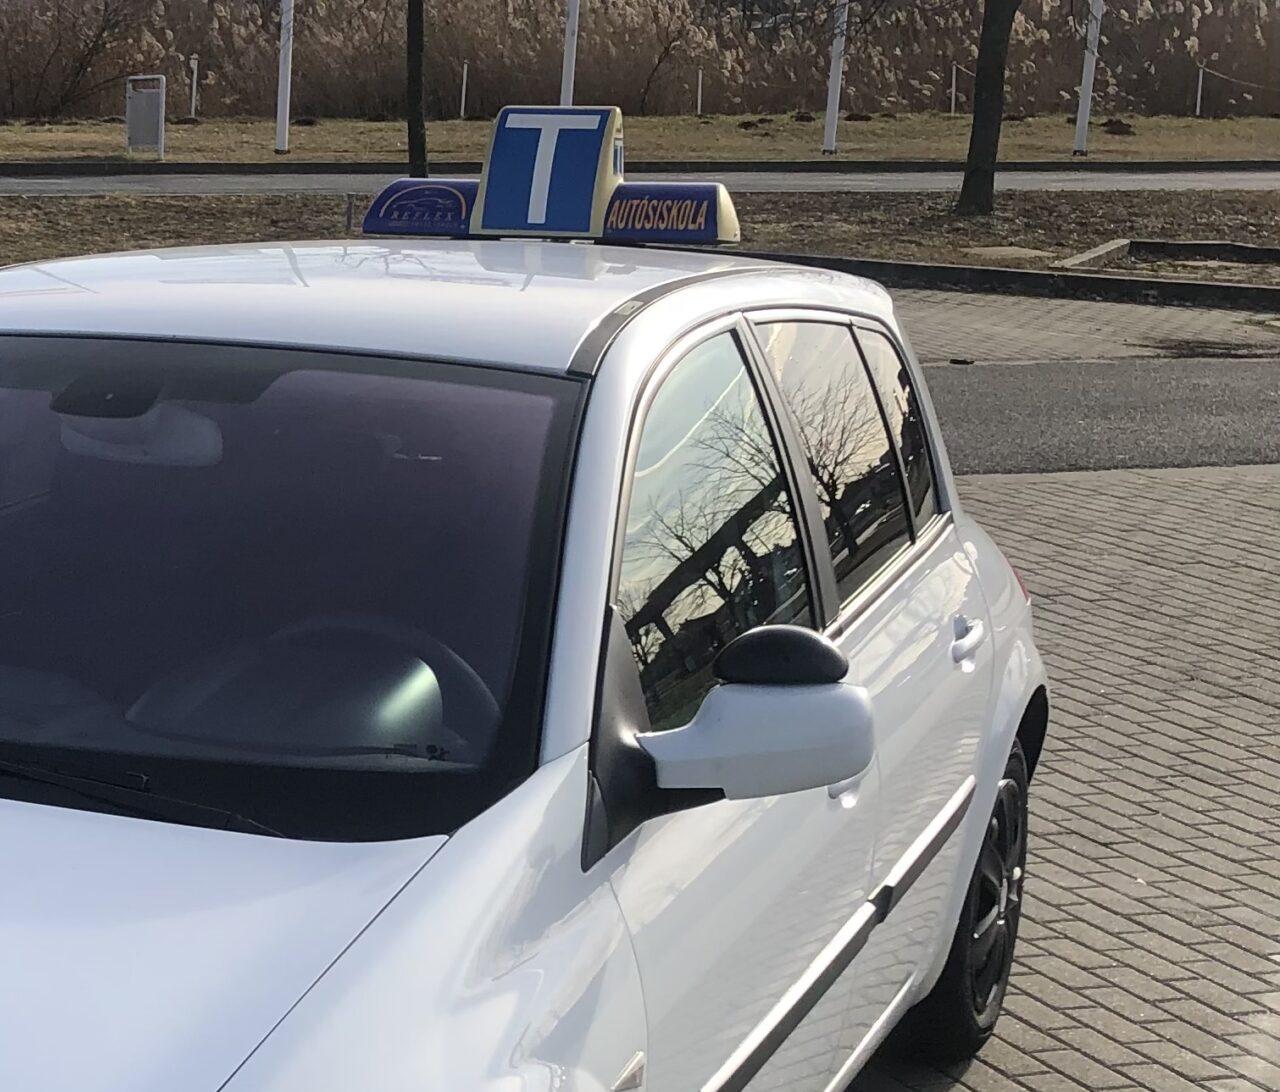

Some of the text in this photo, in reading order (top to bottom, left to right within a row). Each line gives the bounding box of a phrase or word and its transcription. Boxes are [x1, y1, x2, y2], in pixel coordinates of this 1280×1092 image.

[504, 113, 602, 225] T
[391, 210, 455, 220] REFLEX
[607, 195, 707, 230] AUTÓSISKOLA
